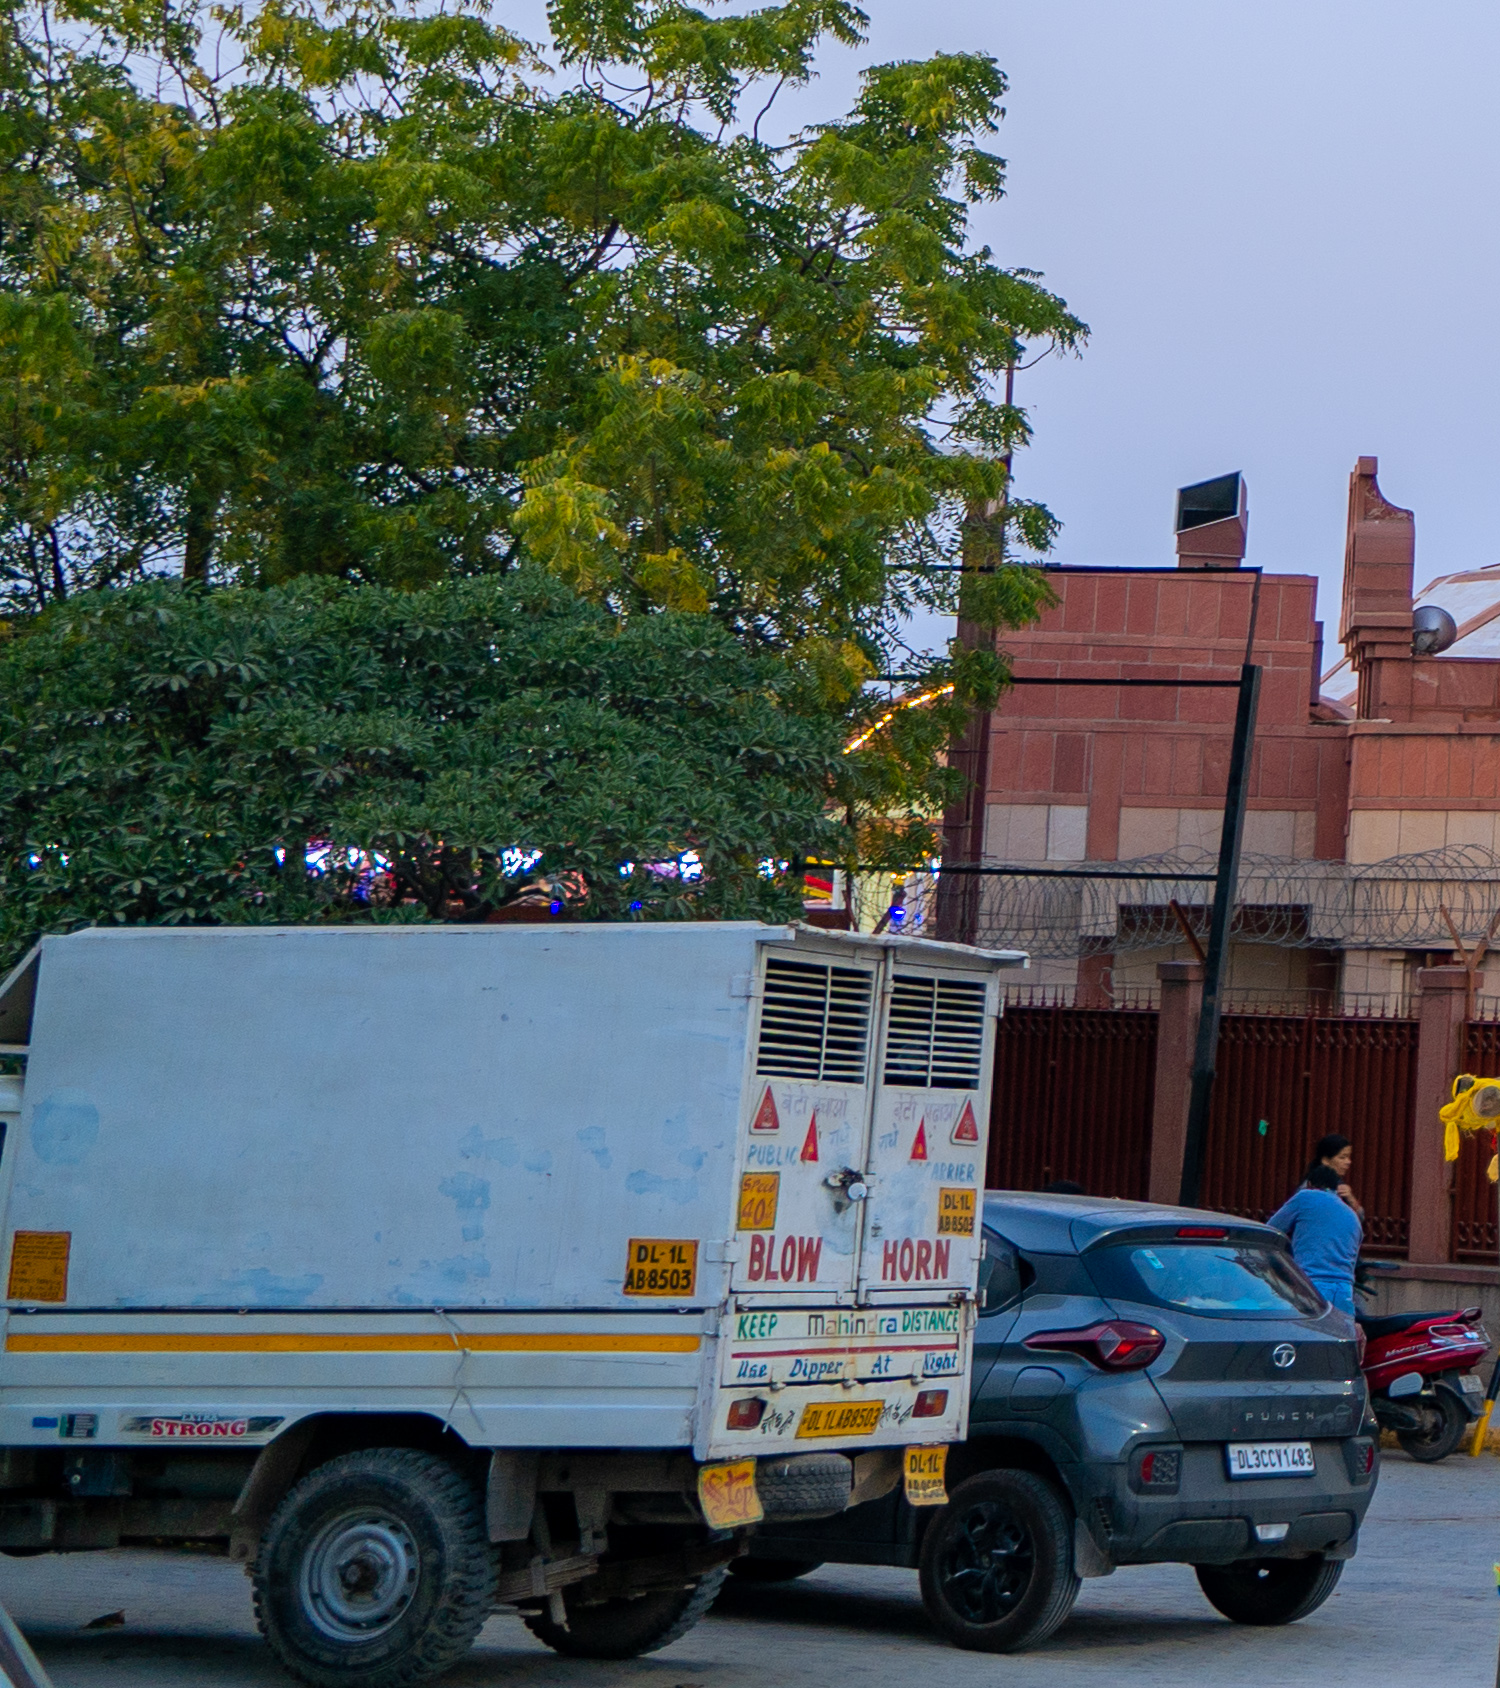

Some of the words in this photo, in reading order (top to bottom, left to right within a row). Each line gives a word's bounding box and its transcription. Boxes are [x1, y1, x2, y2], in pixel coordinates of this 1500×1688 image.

[748, 1144, 797, 1166] PUBLIC
[944, 1193, 970, 1211] DL-1L
[637, 1245, 687, 1264] DL-1L
[748, 1234, 823, 1282] BLOW
[882, 1237, 951, 1282] HORN
[737, 1313, 778, 1340] KEEP
[902, 1310, 958, 1332] DISTANCE
[736, 1361, 768, 1378] Use
[788, 1359, 843, 1380] Dipper
[871, 1355, 892, 1374] At
[922, 1352, 958, 1374] Night
[1245, 1412, 1314, 1421] PUNCH
[151, 1419, 248, 1437] STRONG
